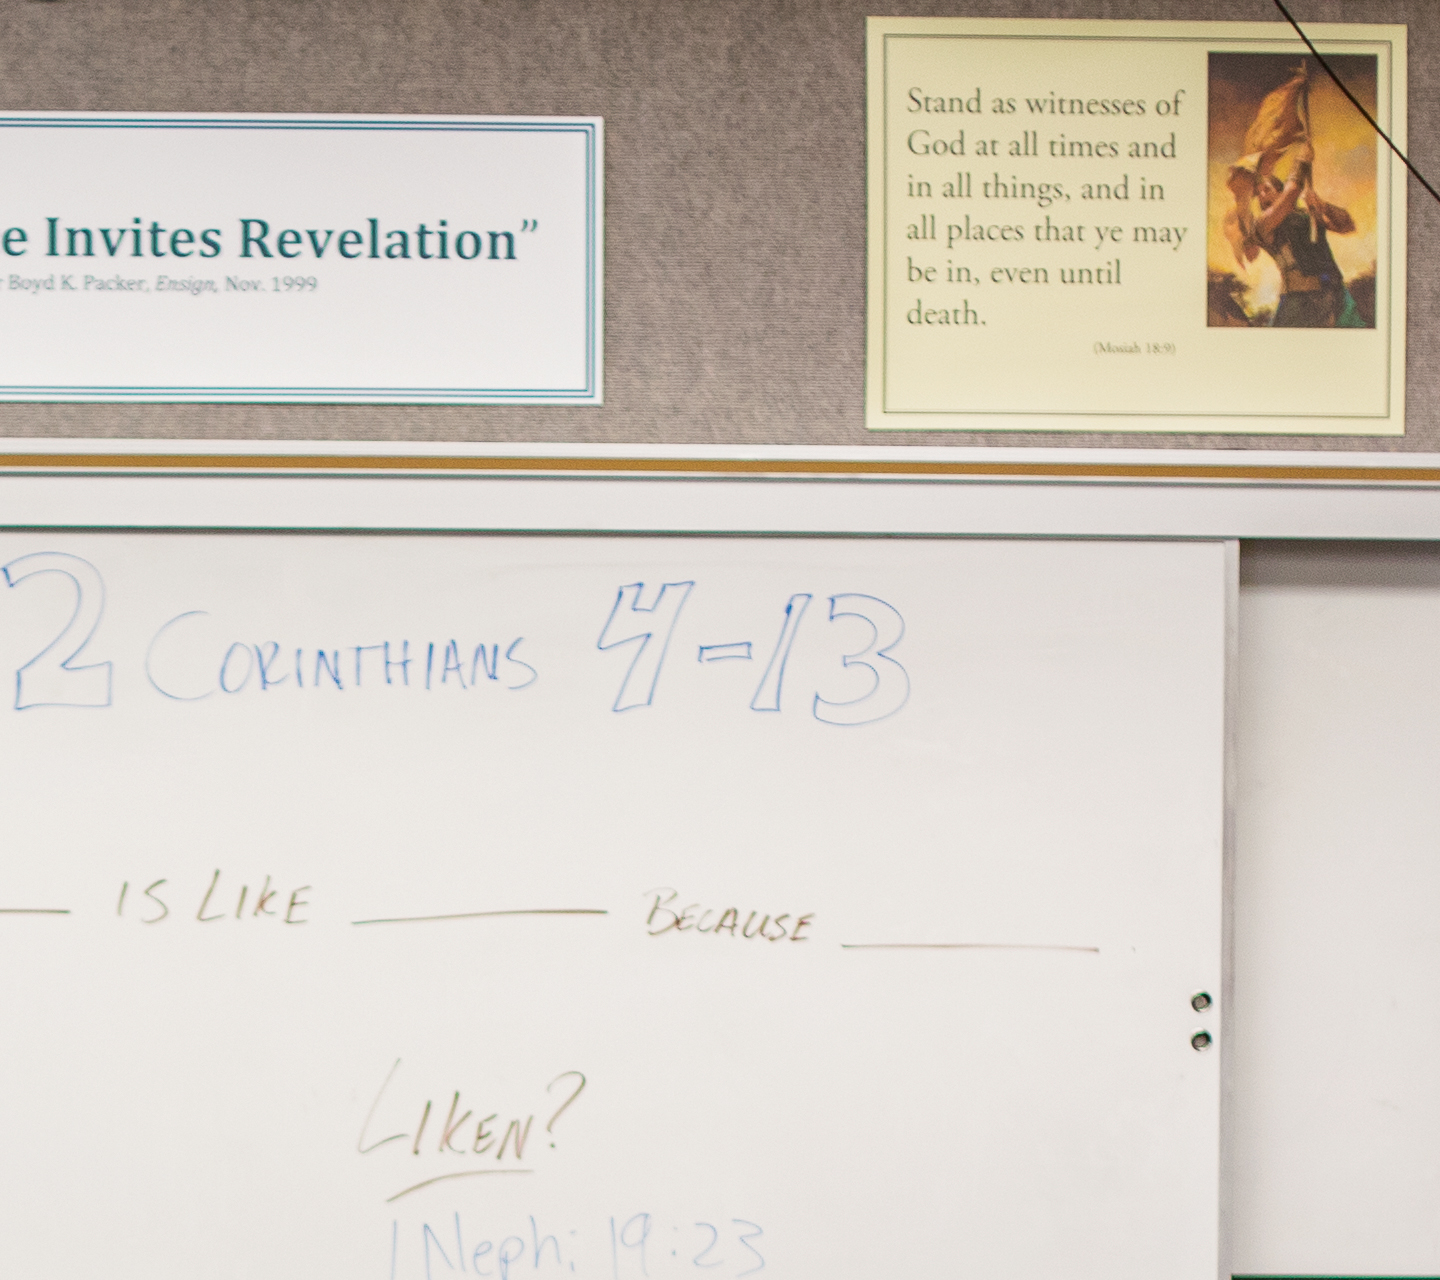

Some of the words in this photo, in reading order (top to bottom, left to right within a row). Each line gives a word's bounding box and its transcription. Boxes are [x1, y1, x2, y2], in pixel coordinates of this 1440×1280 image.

[906, 86, 983, 115] Stand
[991, 97, 1017, 115] as
[1024, 89, 1147, 116] witnesses
[1154, 87, 1186, 116] of
[906, 128, 966, 157] God
[974, 137, 999, 156] at
[1008, 128, 1039, 157] all
[1048, 133, 1120, 159] times
[1127, 130, 1177, 159] and
[907, 173, 933, 199] in
[941, 170, 973, 199] all
[982, 170, 1072, 210] things,
[1080, 171, 1130, 201] and
[1139, 175, 1165, 201] in
[46, 215, 222, 259] Invites
[906, 212, 937, 241] all
[946, 213, 1025, 250] places
[1033, 212, 1085, 243] that
[1094, 225, 1124, 251] ye
[1132, 225, 1188, 251] may
[8, 273, 56, 295] Boyd
[60, 274, 77, 292] K.
[83, 274, 150, 293] Packer,
[154, 274, 219, 298] Ensign,
[224, 275, 265, 293] Nov.
[272, 275, 319, 293] 1999
[906, 255, 938, 284] be
[946, 258, 981, 286] in,
[989, 266, 1050, 285] even
[1059, 256, 1121, 285] until
[905, 297, 987, 326] death.
[595, 579, 907, 727] 4-13
[116, 877, 170, 926] IS
[608, 1211, 766, 1277] 19:23
